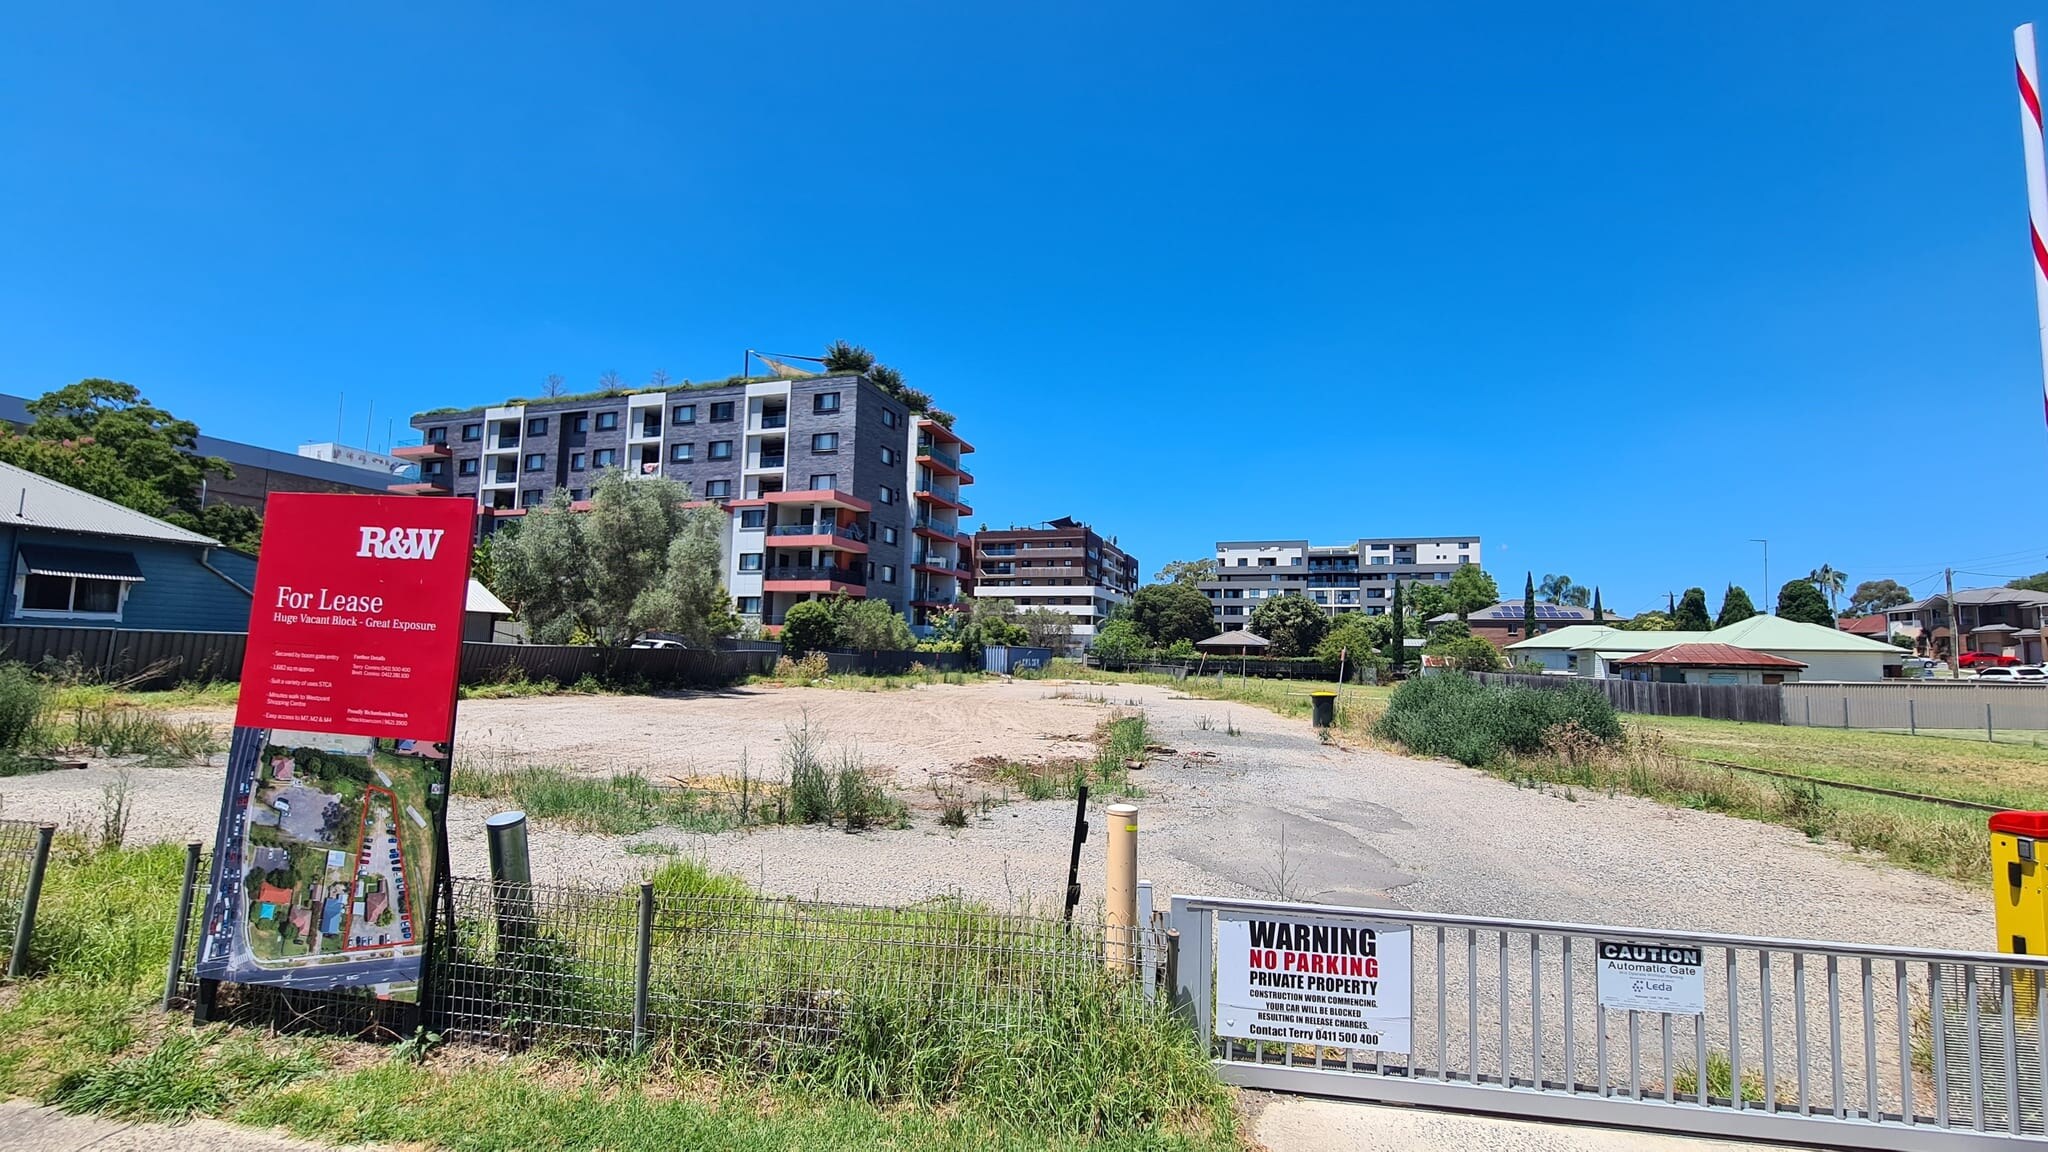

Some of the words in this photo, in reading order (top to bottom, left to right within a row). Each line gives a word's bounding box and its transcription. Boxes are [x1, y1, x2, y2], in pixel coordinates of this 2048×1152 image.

[356, 526, 445, 560] R&W
[275, 586, 313, 609] For
[319, 588, 384, 614] Lease
[274, 612, 298, 624] Huge
[300, 614, 330, 626] Vacant
[332, 615, 357, 627] Block
[366, 618, 390, 630] Great
[392, 619, 436, 632] Exposure
[1249, 920, 1377, 957] WARNING
[1250, 949, 1277, 970] NO
[1284, 952, 1378, 978] PARKING
[1604, 944, 1698, 964] CAUTION
[1608, 960, 1666, 974] Automatic
[1669, 965, 1696, 976] Gate
[1250, 971, 1304, 990] PRIVATE
[1308, 976, 1378, 996] PROPERTY
[1646, 981, 1672, 992] Leda
[1250, 989, 1302, 1001] CONSTRUCTION
[1304, 993, 1327, 1003] WORK
[1328, 994, 1378, 1008] COMMENCING.
[1266, 1002, 1284, 1012] YOUR
[1285, 1003, 1300, 1012] CAR
[1301, 1004, 1318, 1014] WILL
[1320, 1006, 1328, 1015] BE
[1330, 1006, 1361, 1018] BLOCKED
[1258, 1012, 1294, 1023] RESULTING
[1296, 1014, 1304, 1023] IN
[1305, 1014, 1333, 1026] RELEASE
[1334, 1017, 1369, 1030] CHARGES.
[1250, 1024, 1287, 1038] Contact
[1288, 1027, 1313, 1042] Terry
[1315, 1028, 1336, 1042] 0411
[1338, 1031, 1358, 1044] 500
[1360, 1032, 1378, 1046] 400
